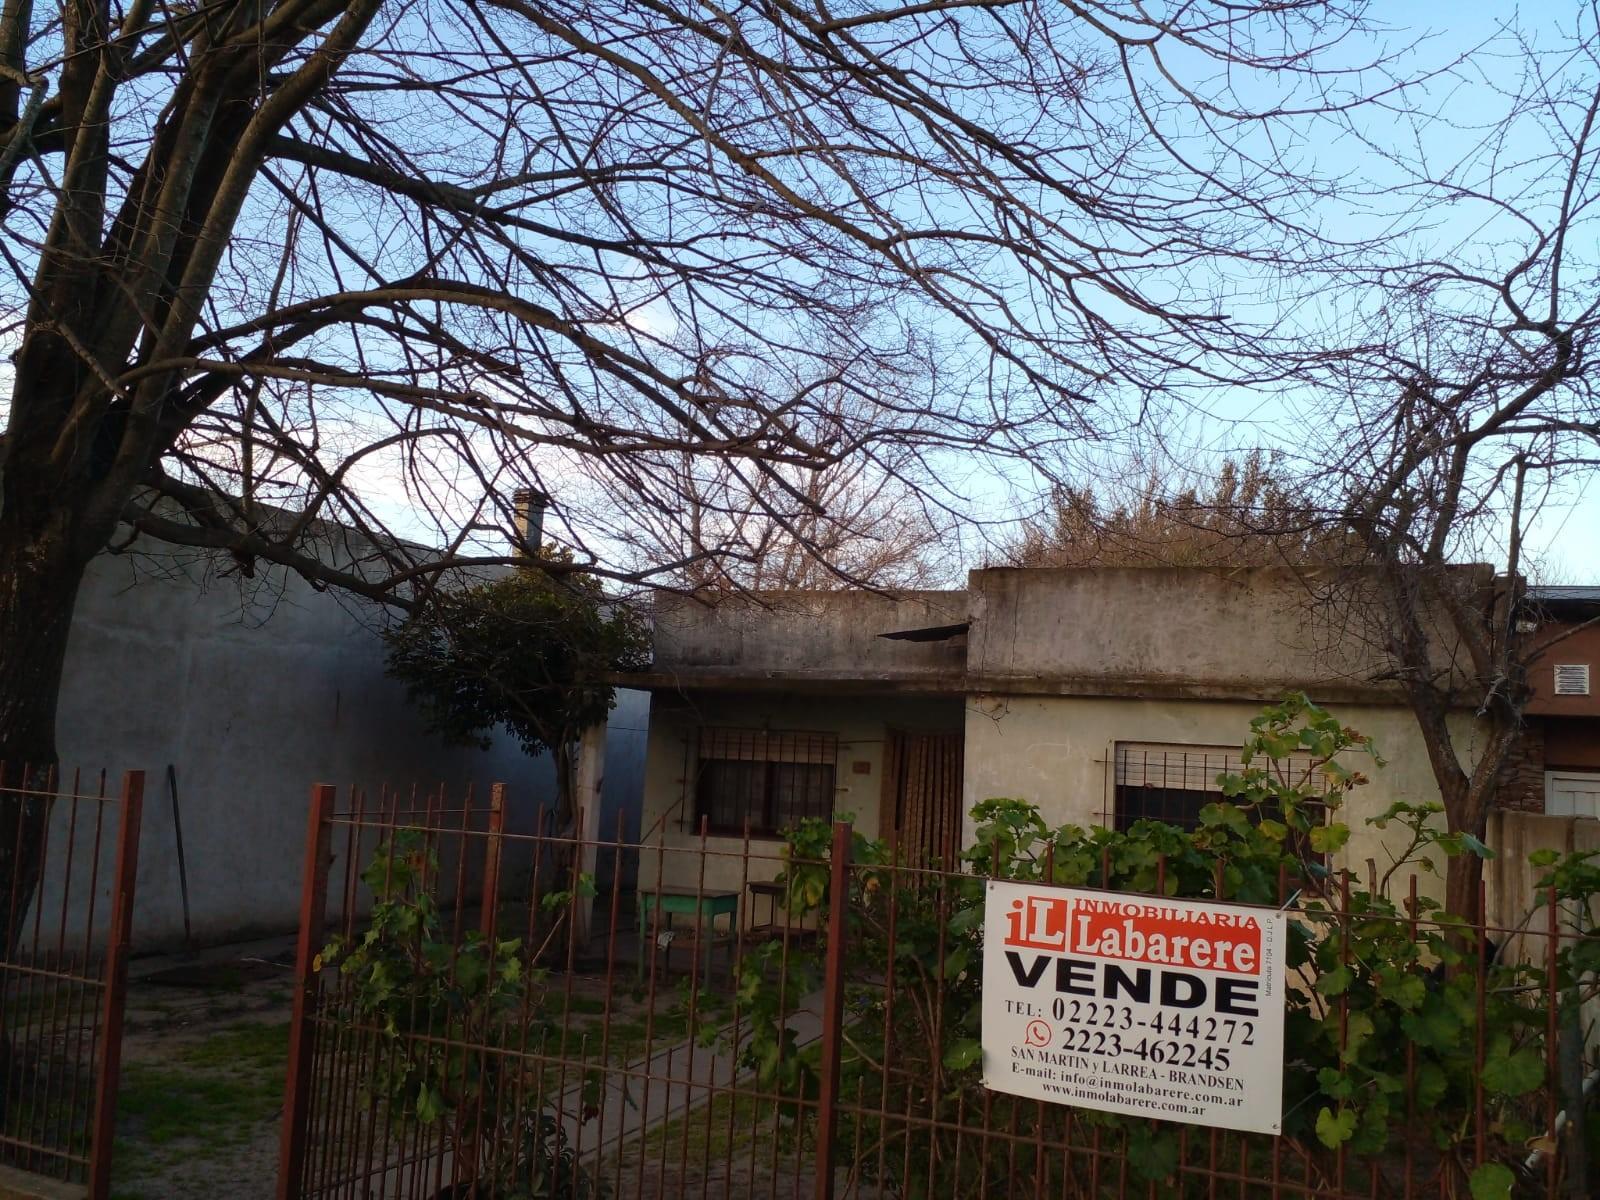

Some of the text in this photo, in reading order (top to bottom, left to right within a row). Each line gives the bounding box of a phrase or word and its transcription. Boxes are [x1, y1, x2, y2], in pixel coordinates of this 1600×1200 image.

[1074, 898, 1260, 929] INMOBILIARIA
[1076, 914, 1255, 972] Labarere
[1004, 950, 1259, 1017] VENDE
[1004, 997, 1255, 1046] TEL: 02223-444272
[1011, 1046, 1034, 1061] SAN
[1037, 1051, 1089, 1070] MARTIN
[1092, 1060, 1099, 1074] y
[1102, 1060, 1158, 1080] LARREA
[1169, 1070, 1245, 1091] BRANDSEN
[1062, 1027, 1231, 1072] 2223-462245
[1012, 1062, 1245, 1107] E-mail: info@inmolabarere.com.ar
[1042, 1083, 1207, 1116] www.inmolabarere.com.ar
